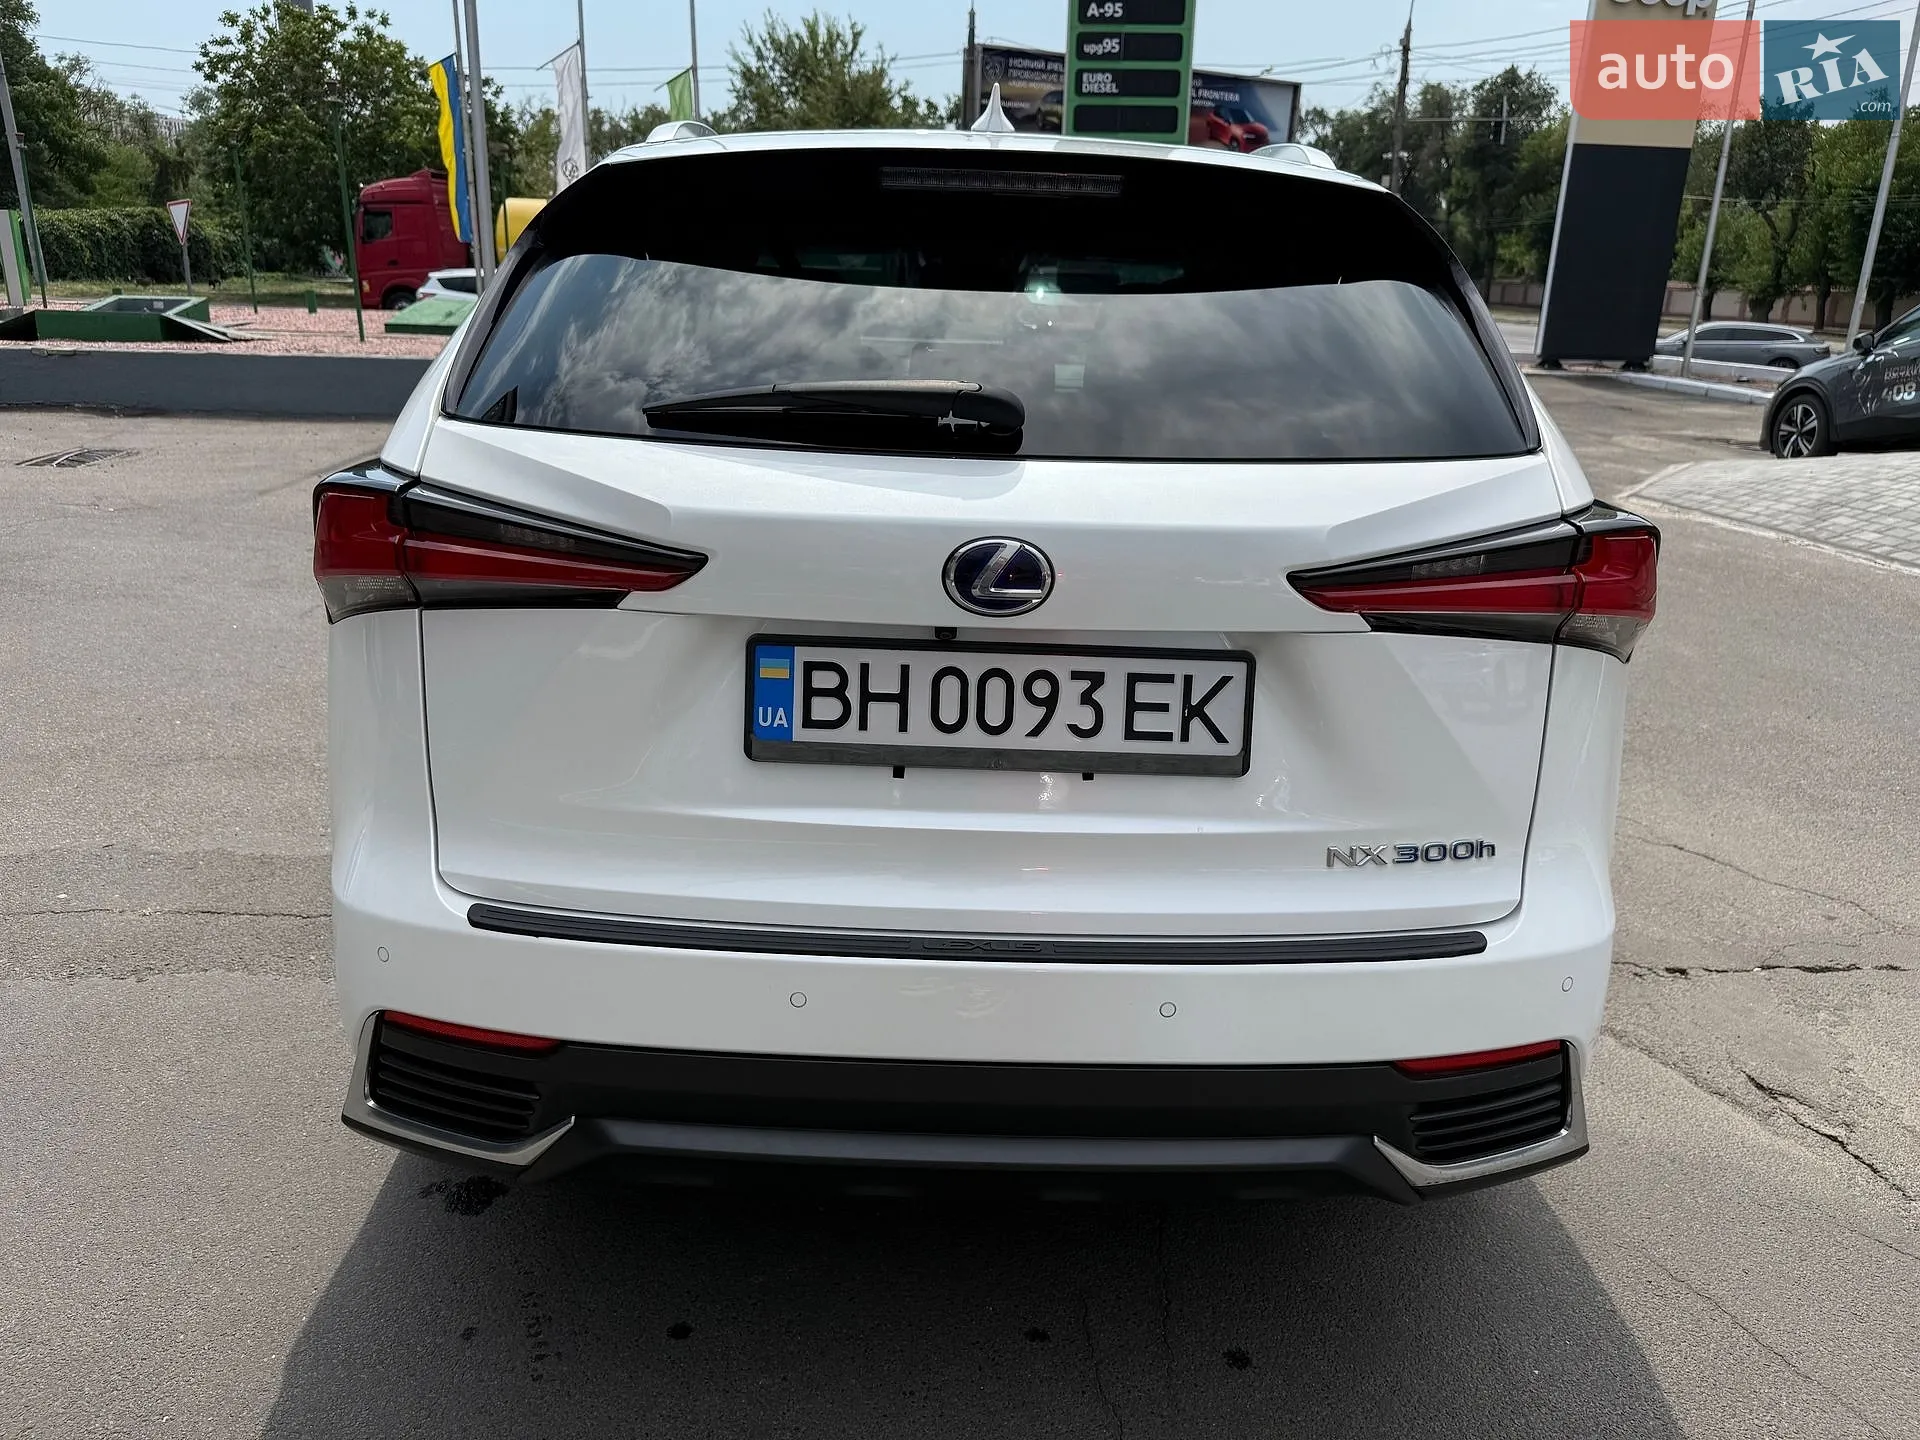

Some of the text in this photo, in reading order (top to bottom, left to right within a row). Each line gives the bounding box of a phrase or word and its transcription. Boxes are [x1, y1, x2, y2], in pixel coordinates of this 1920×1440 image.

[1081, 82, 1120, 93] DIESEL
[1082, 72, 1113, 83] EURO
[801, 660, 1235, 745] BH 0093 EK
[758, 706, 789, 729] UA
[1326, 837, 1497, 868] NX 300h
